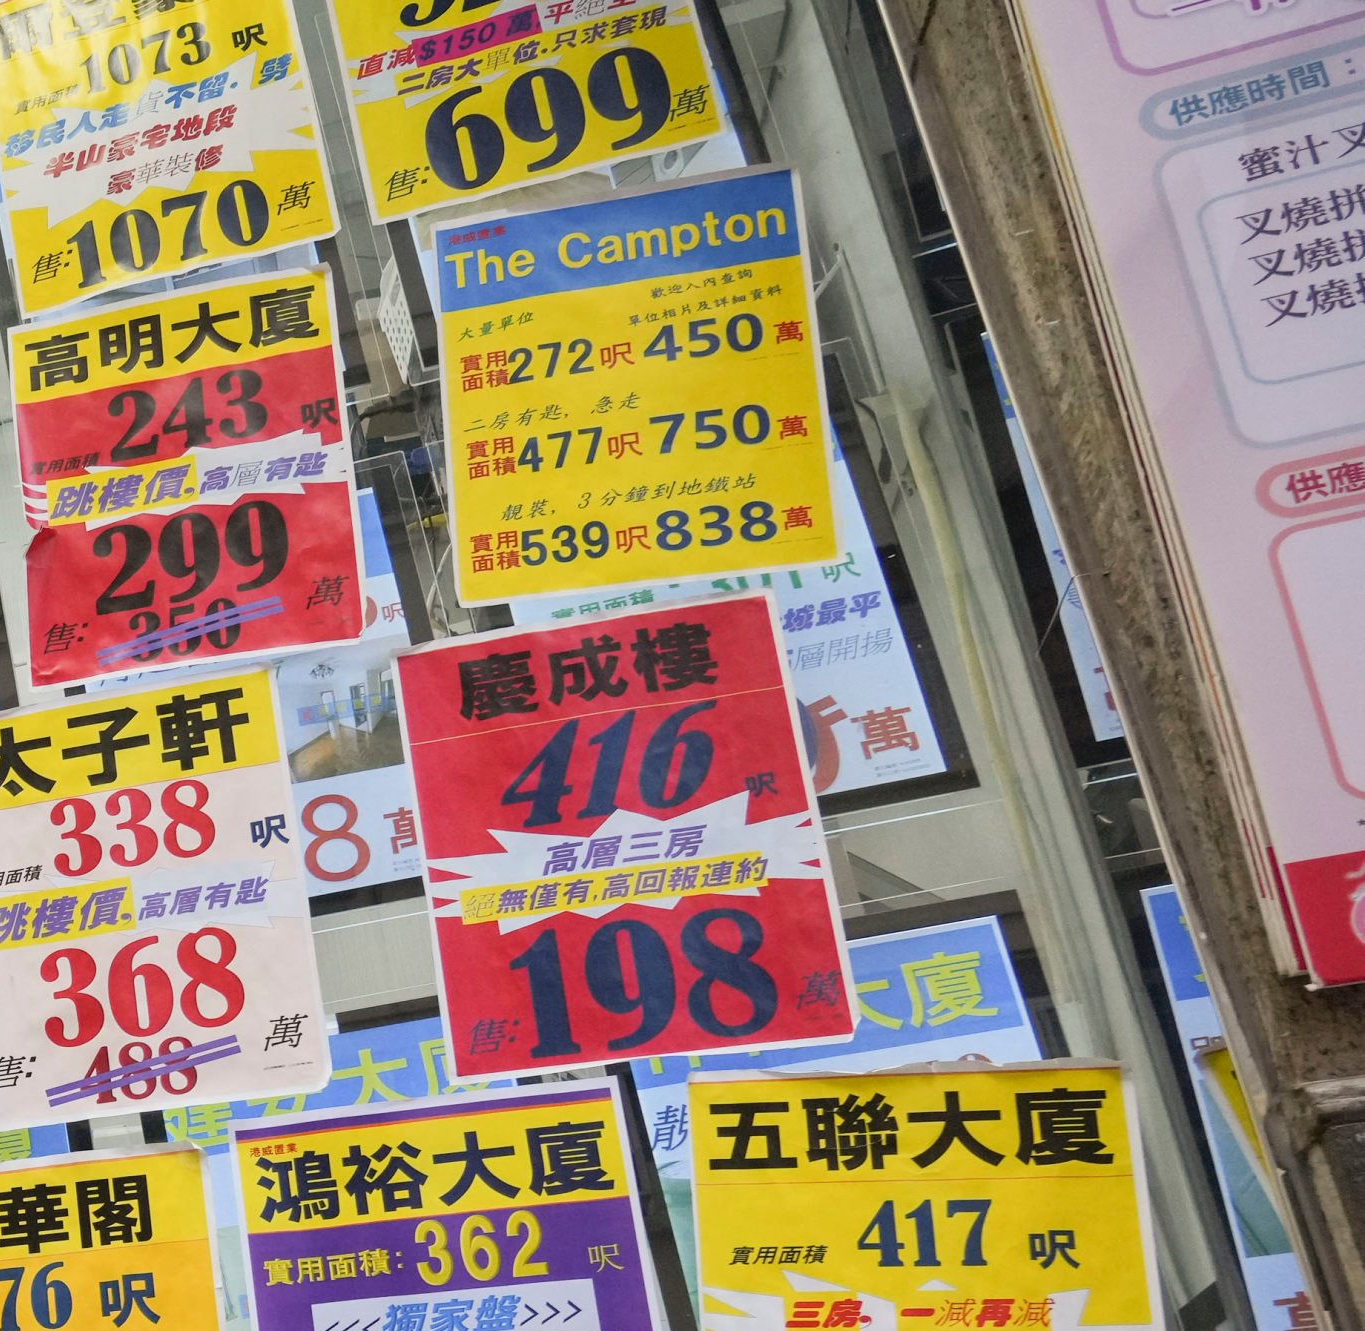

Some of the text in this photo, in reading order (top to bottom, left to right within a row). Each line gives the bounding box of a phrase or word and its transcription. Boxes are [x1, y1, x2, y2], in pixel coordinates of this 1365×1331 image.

[81, 21, 212, 95] 1073
[425, 46, 673, 191] 699
[68, 179, 270, 289] 1070
[444, 246, 535, 291] The
[557, 202, 788, 264] Campton
[24, 285, 321, 394] 高明大廈
[508, 312, 765, 384] 272 450
[106, 367, 273, 465] 243
[518, 405, 771, 474] 477 750
[92, 498, 292, 619] 299
[520, 500, 779, 569] 539 838
[459, 622, 720, 723] 慶成樓
[500, 698, 718, 829] 416
[50, 778, 218, 878] 338
[543, 824, 708, 876] 高層三房
[39, 927, 247, 1049] 368
[508, 908, 779, 1059] 198
[255, 1120, 618, 1224] 鴻裕大廈
[707, 1087, 1116, 1172] 五聯大廈
[415, 1211, 551, 1288] 362
[856, 1197, 994, 1269] 417
